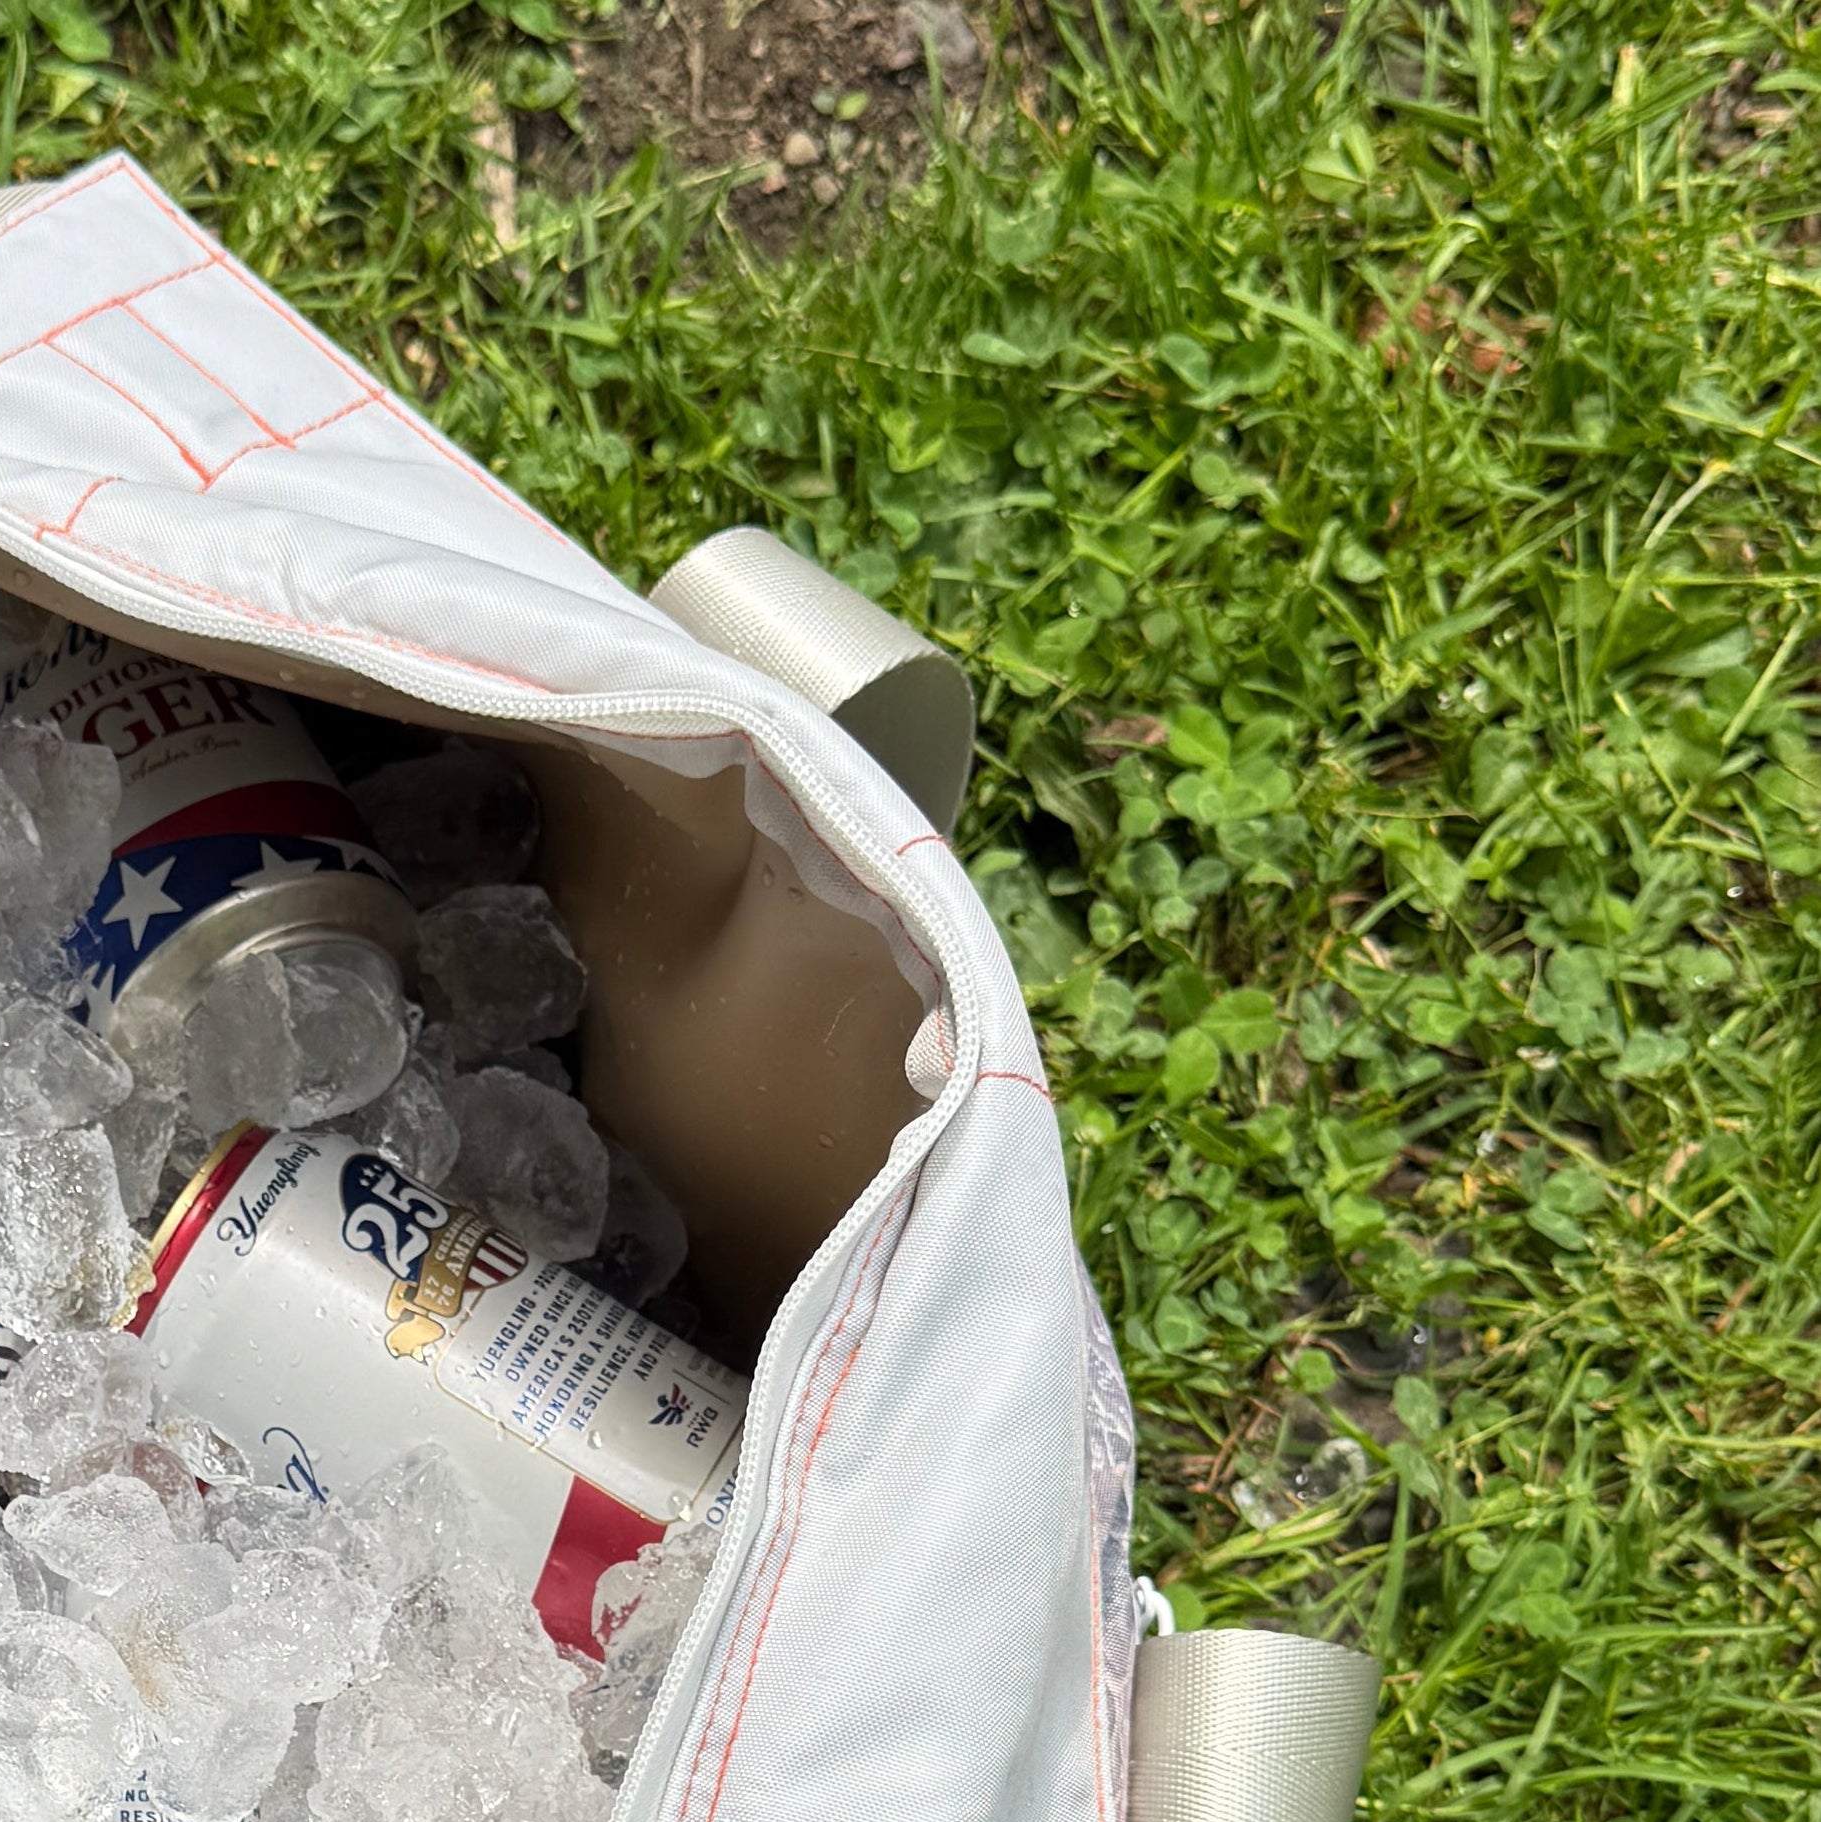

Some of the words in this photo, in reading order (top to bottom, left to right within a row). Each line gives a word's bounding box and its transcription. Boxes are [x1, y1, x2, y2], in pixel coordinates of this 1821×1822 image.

[82, 675, 277, 762] GER
[217, 1139, 319, 1256] Yuengling
[345, 1164, 457, 1279] 25
[472, 1296, 537, 1384] YUENGLING
[505, 1323, 549, 1383] OWNED
[544, 1291, 574, 1325] SINCE
[512, 1334, 575, 1424] AMERICA'S
[632, 1353, 658, 1381] AND
[533, 1352, 596, 1438] HONORING
[587, 1338, 605, 1353] A
[568, 1342, 636, 1433] RESILIENCE,
[685, 1407, 719, 1448] RWB
